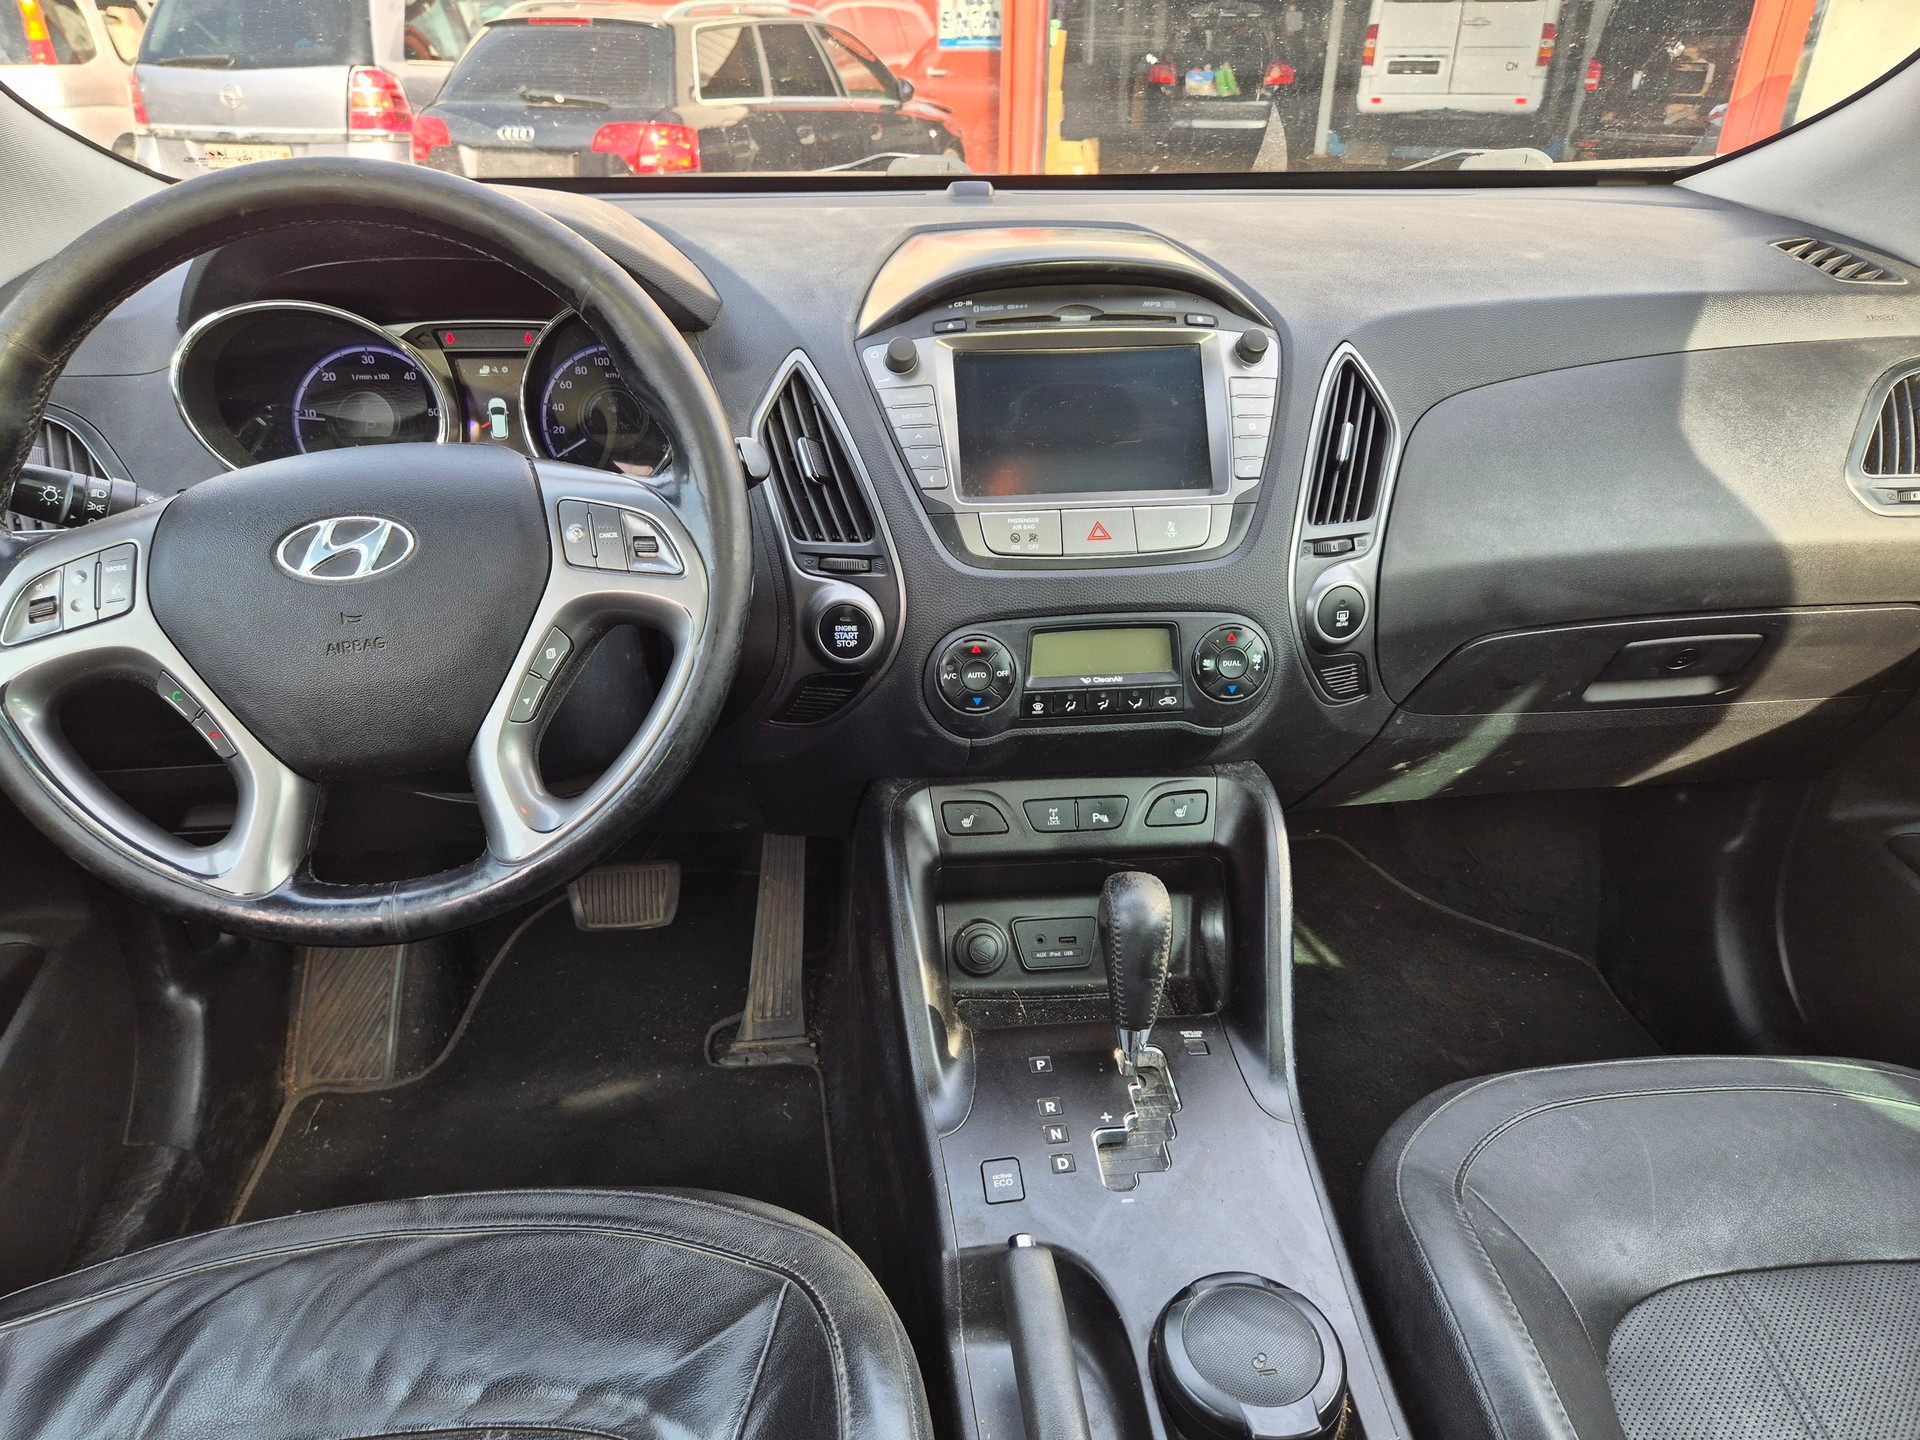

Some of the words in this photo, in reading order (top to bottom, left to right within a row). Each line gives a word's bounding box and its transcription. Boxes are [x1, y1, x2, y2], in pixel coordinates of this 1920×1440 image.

[362, 355, 375, 365] 30
[594, 357, 610, 366] 100
[574, 366, 588, 376] 80
[322, 372, 336, 382] 20
[404, 372, 416, 381] 40
[559, 380, 573, 390] 60
[427, 407, 439, 417] 50
[551, 403, 565, 412] 40
[303, 409, 316, 419] 10
[553, 425, 566, 435] 20
[106, 565, 128, 573] MODE
[834, 632, 859, 640] START
[325, 636, 386, 657] AIRBAG
[836, 640, 858, 648] STOP
[943, 672, 957, 680] A/C
[967, 671, 987, 679] AUTO
[1092, 675, 1123, 683] CleanAir
[1036, 1060, 1046, 1070] P
[1045, 1102, 1056, 1113] R
[1051, 1128, 1063, 1140] N
[1056, 1157, 1069, 1170] D
[993, 1179, 1014, 1188] ECO
